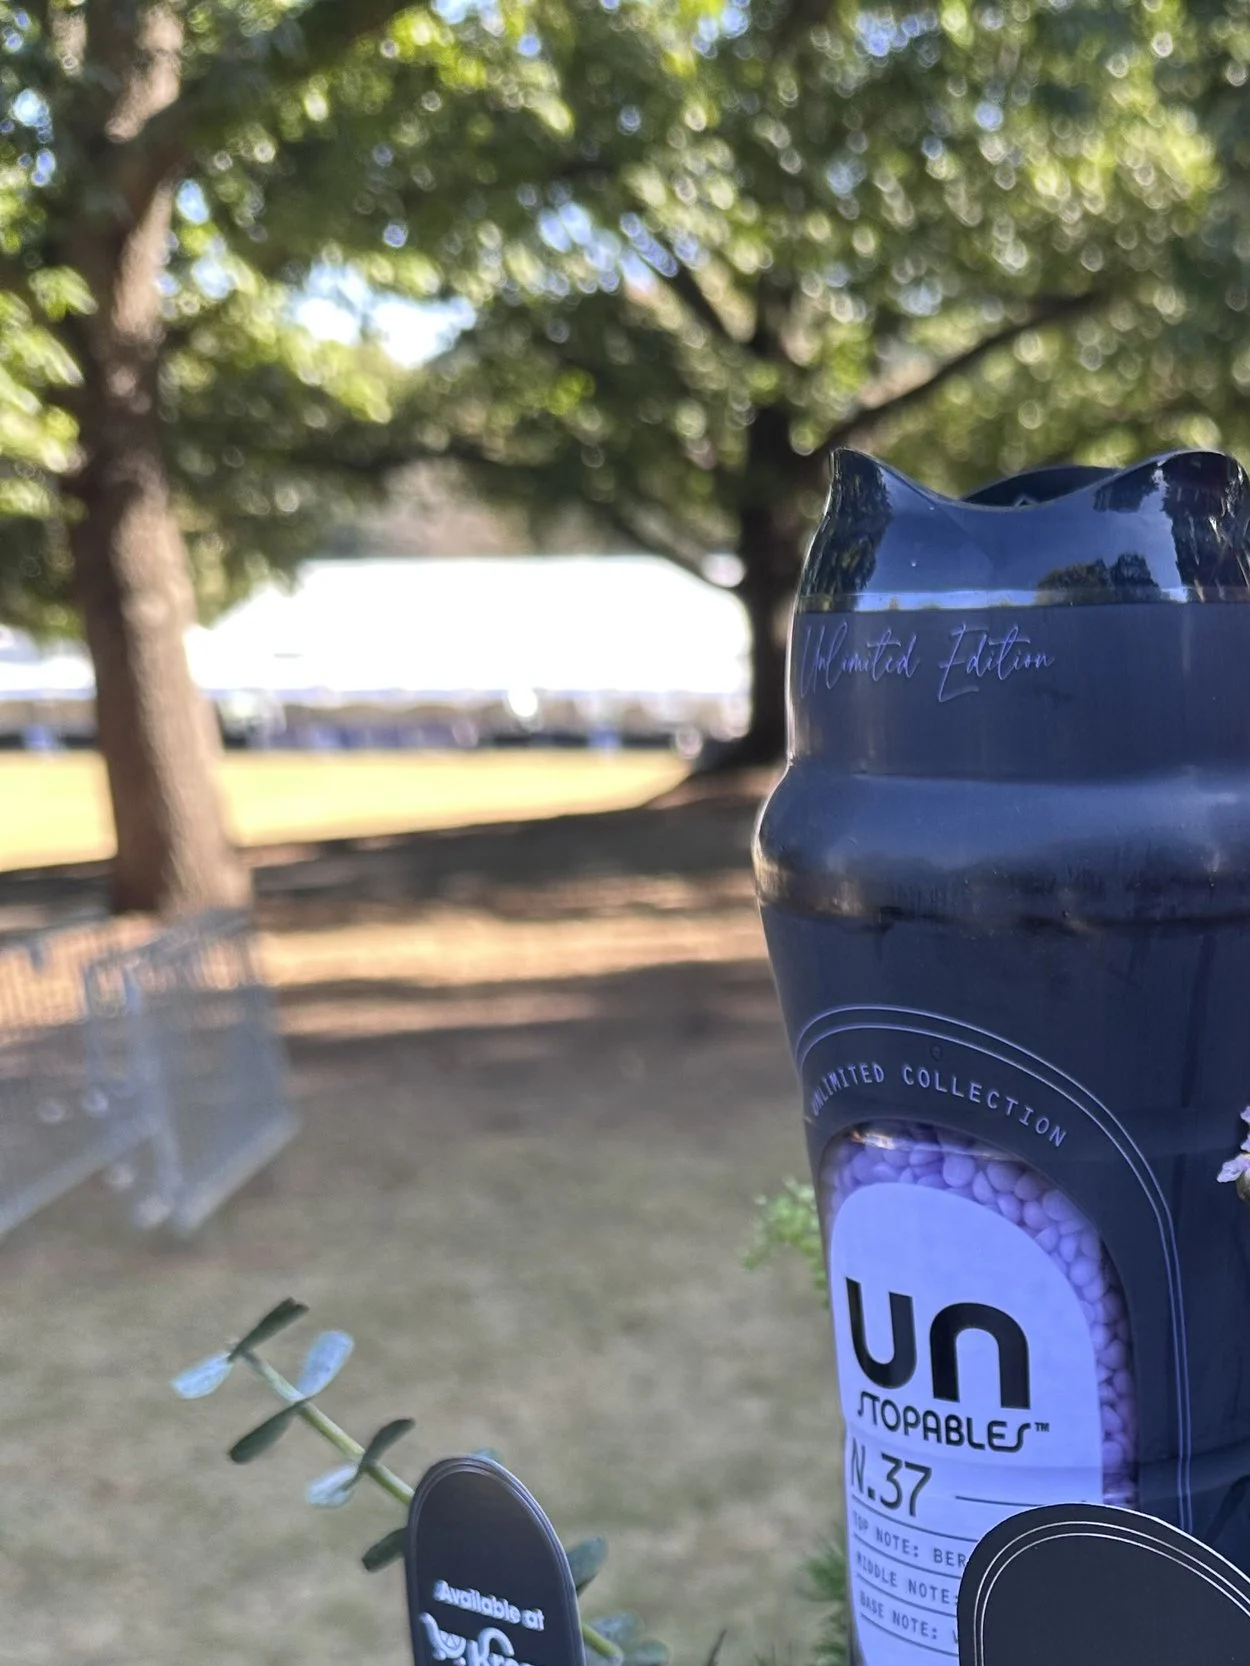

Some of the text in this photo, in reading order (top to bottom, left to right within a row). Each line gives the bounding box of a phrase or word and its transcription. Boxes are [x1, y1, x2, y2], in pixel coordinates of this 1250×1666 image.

[801, 621, 1054, 702] Unlimited Edition
[903, 1064, 1067, 1148] COLLECTION
[851, 1436, 932, 1517] N.37
[853, 1511, 869, 1533] TOP
[876, 1528, 919, 1557] NOTE:
[856, 1552, 898, 1588] MIDDLE
[432, 1579, 545, 1631] Available at
[860, 1590, 884, 1618] BASE
[892, 1609, 938, 1639] NOTE:
